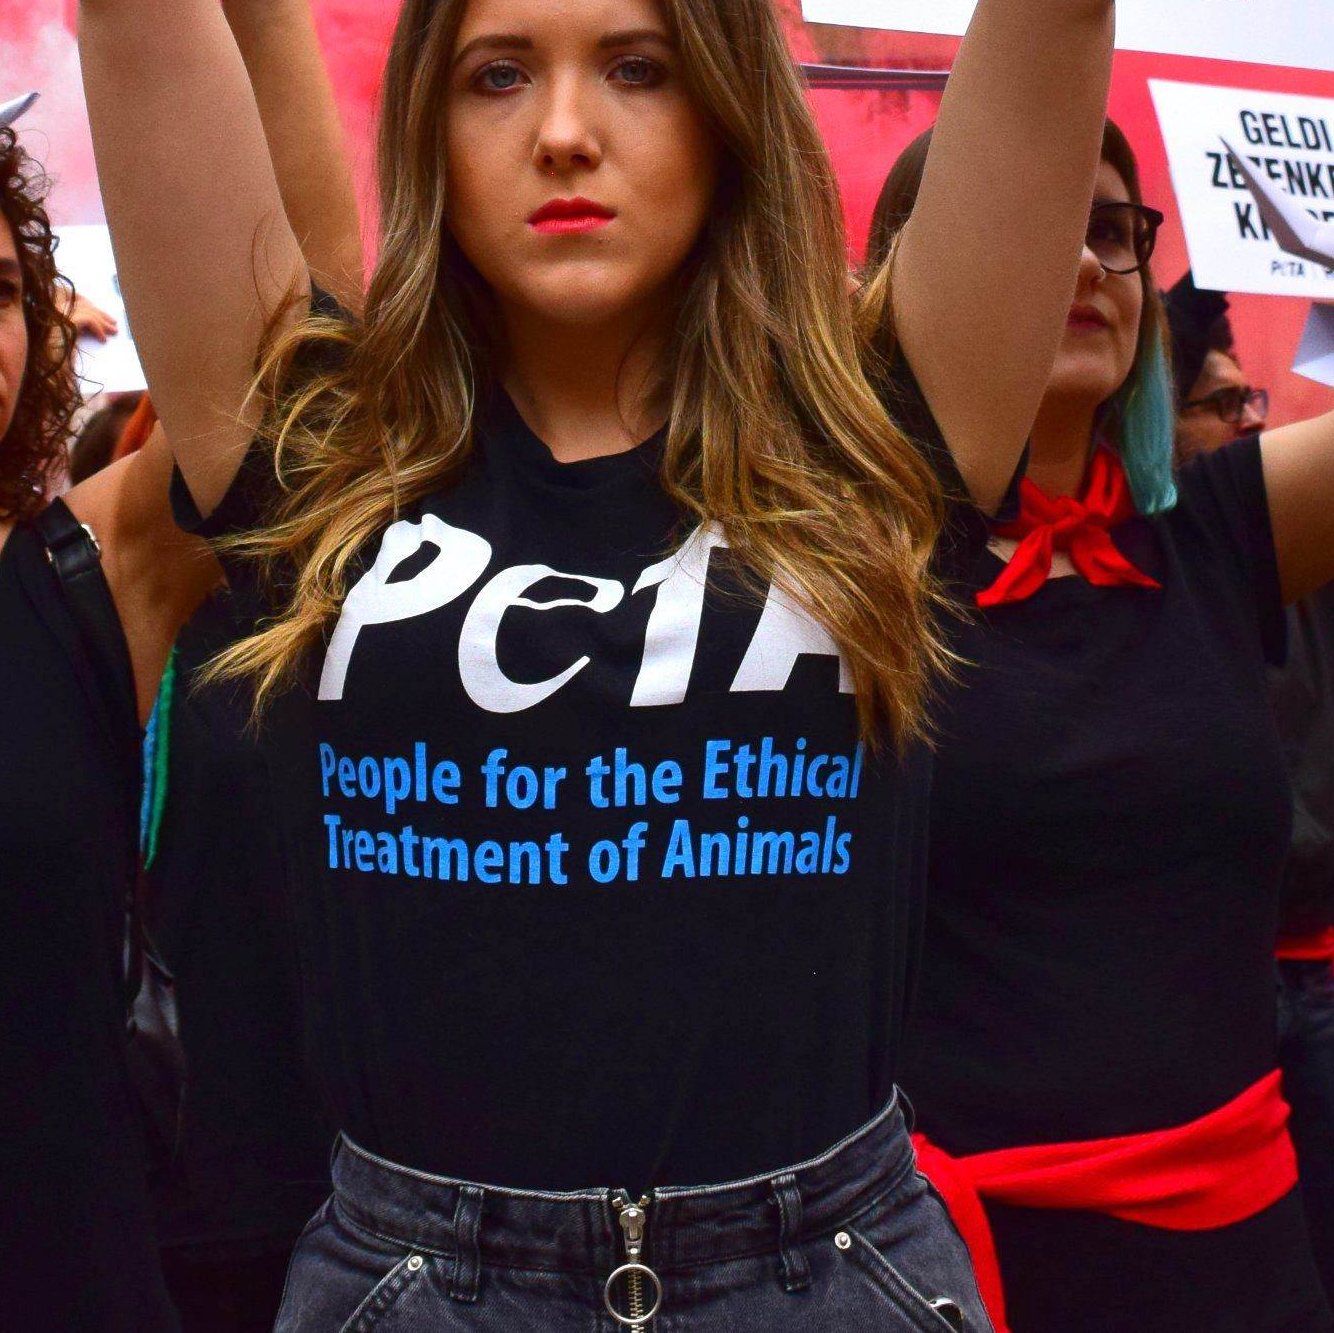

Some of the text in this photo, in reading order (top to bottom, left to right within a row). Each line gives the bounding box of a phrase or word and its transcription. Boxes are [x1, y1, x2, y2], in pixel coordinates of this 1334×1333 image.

[1240, 110, 1333, 153] GELDI
[319, 736, 863, 814] People for the Ethical
[323, 814, 852, 886] Treatment of Animals
